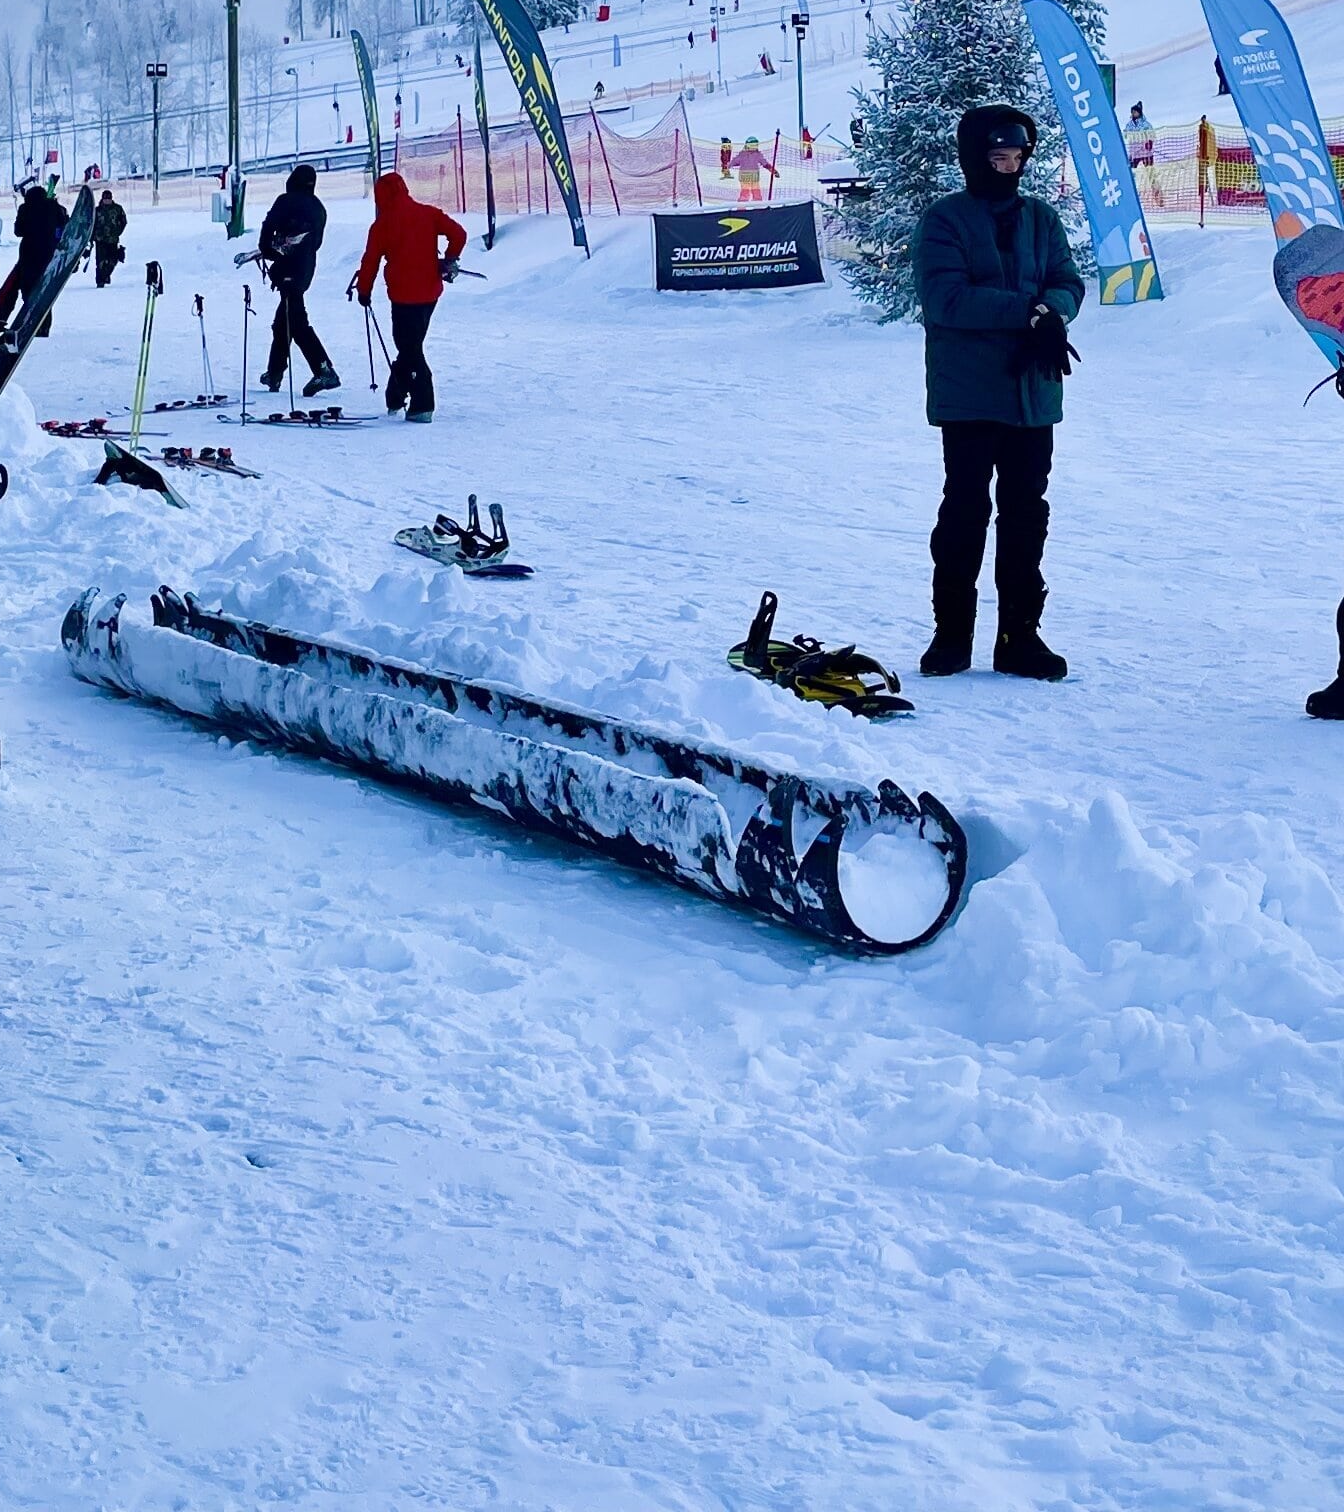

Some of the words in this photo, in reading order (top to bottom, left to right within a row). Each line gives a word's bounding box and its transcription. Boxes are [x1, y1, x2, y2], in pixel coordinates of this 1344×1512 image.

[671, 245, 734, 261] ЗОЛОТАЯ
[736, 240, 798, 261] ДОЛИНА
[727, 266, 749, 276] ЦЕНТР
[752, 262, 800, 274] ПАРК-ОТЕЛЬ
